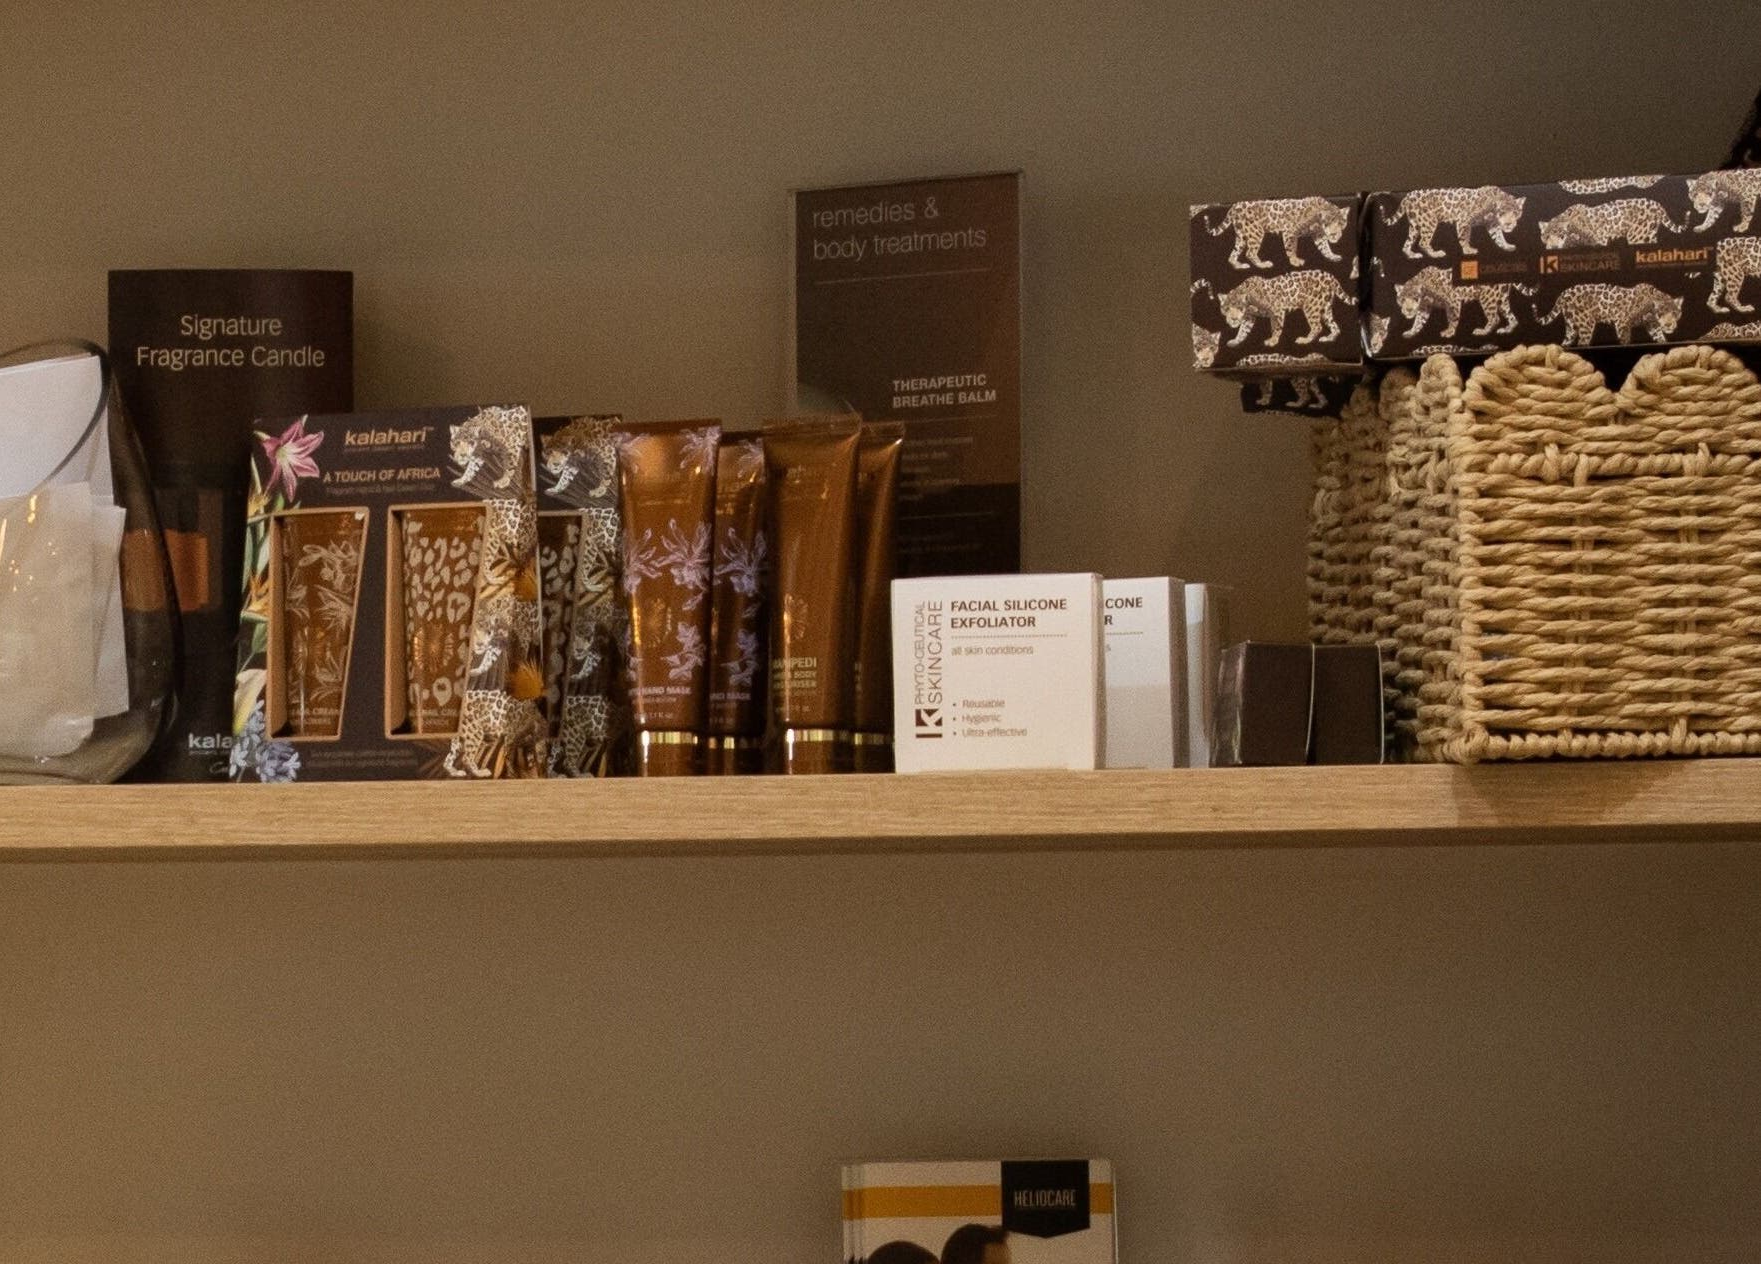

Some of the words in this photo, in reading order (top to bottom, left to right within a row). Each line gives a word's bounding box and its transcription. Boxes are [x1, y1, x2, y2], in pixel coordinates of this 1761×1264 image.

[812, 202, 915, 228] remedies
[924, 197, 939, 219] &
[813, 239, 867, 262] body
[874, 227, 987, 256] treatments
[1635, 248, 1708, 264] kalahari
[181, 314, 282, 339] Signature
[137, 346, 245, 371] Fragrance
[251, 346, 326, 367] Candle
[893, 374, 987, 392] THERAPEUTIC
[893, 393, 954, 409] BREATHE
[958, 390, 997, 404] BALM
[345, 428, 427, 446] kalahari
[323, 472, 331, 482] A
[335, 470, 376, 482] TOUCH
[379, 469, 395, 480] OF
[397, 467, 441, 480] AFRICA
[950, 600, 999, 612] FACIAL
[1004, 598, 1067, 611] SILICONE
[950, 616, 1036, 629] EXFOLIATOR
[915, 602, 925, 705] PHYTO-CEUTICAL
[928, 601, 943, 704] SKINCARE
[951, 645, 963, 655] all
[964, 645, 984, 655] skin
[985, 645, 1034, 655] conditions
[962, 698, 1006, 709] Reusable
[189, 733, 235, 749] kala
[1014, 1189, 1077, 1209] HELIOCARE
